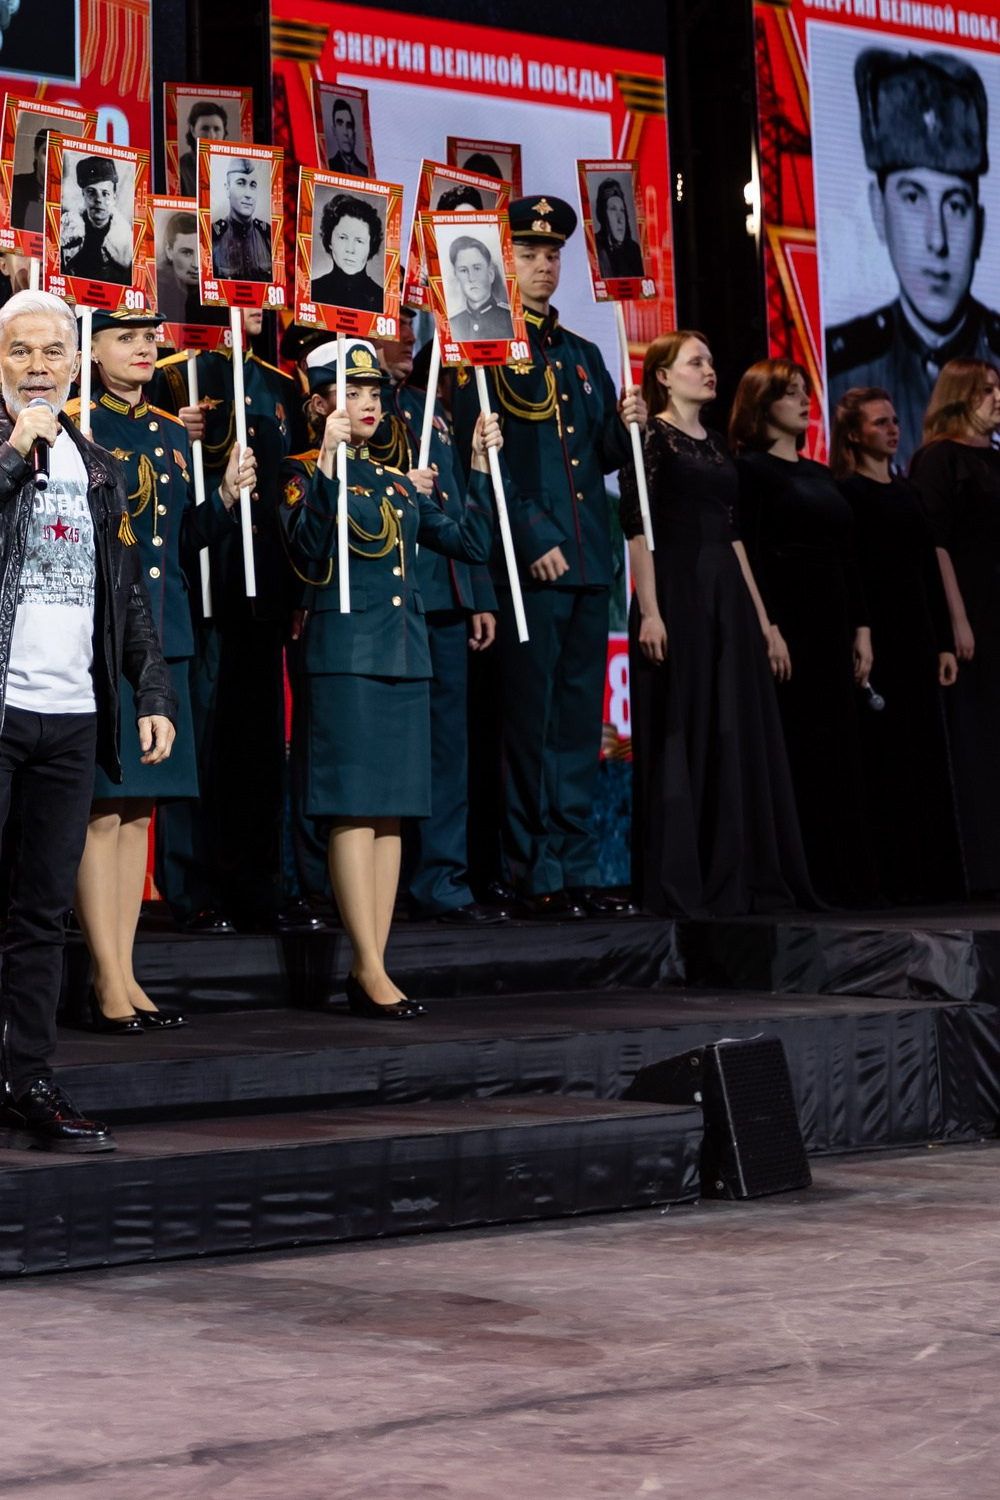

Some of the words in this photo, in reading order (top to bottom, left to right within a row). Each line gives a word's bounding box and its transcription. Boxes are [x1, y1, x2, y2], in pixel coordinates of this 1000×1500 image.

[958, 10, 1000, 45] ПОБЕ
[333, 30, 425, 73] ЭНЕРГИЯ
[430, 45, 524, 87] ВЕЛИКОЙ
[528, 61, 613, 103] ПОБЕДЫ
[62, 139, 87, 151] ЭНЕРГИЯ
[87, 143, 113, 156] ВЕЛИКОЙ
[113, 148, 138, 161] ПОБЕДЫ
[177, 200, 197, 209] ВЕЛИК
[0, 229, 15, 239] 1945
[50, 275, 66, 286] 1945
[125, 290, 144, 309] 80
[268, 286, 284, 305] 80
[299, 302, 316, 313] 1945
[299, 312, 316, 323] 2025
[376, 317, 396, 337] 80
[444, 343, 460, 352] 1945
[510, 341, 529, 360] 80
[445, 352, 461, 362] 2025
[68, 528, 79, 543] 45
[608, 652, 632, 738] 8
